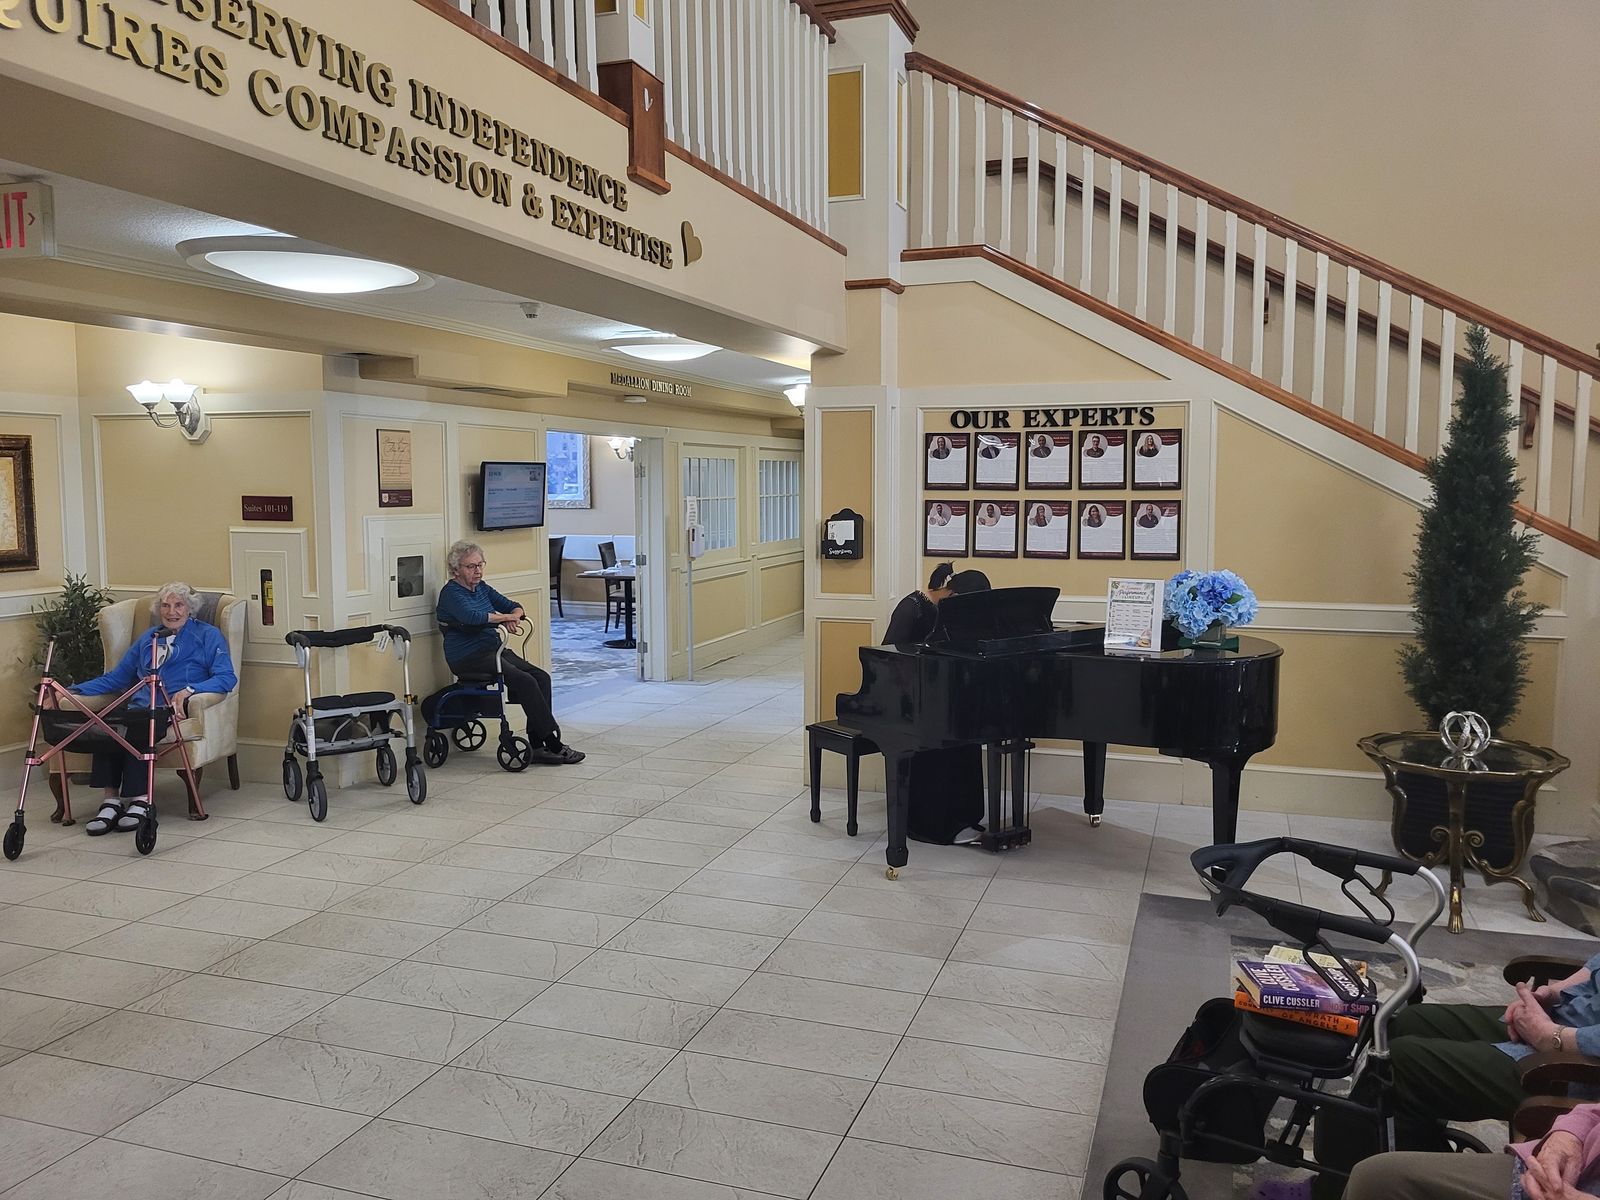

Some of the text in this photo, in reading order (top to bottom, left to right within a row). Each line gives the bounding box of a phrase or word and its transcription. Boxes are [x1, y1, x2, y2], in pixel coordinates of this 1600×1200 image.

[409, 78, 629, 212] INDEPENDENCE
[248, 68, 512, 207] COMPASSION
[522, 183, 544, 219] &
[551, 194, 673, 270] EXPERTISE
[0, 191, 28, 249] IT
[611, 372, 693, 397] MEDALLION DINING ROOM
[950, 406, 1155, 429] OUR EXPERTS
[264, 504, 288, 513] 101-119
[1263, 994, 1285, 1005] CLIVE
[1286, 997, 1320, 1008] CUSSLER
[1350, 1003, 1370, 1014] SHIP
[1298, 1016, 1338, 1030] ANGELS
[1304, 1011, 1339, 1024] WRATH
